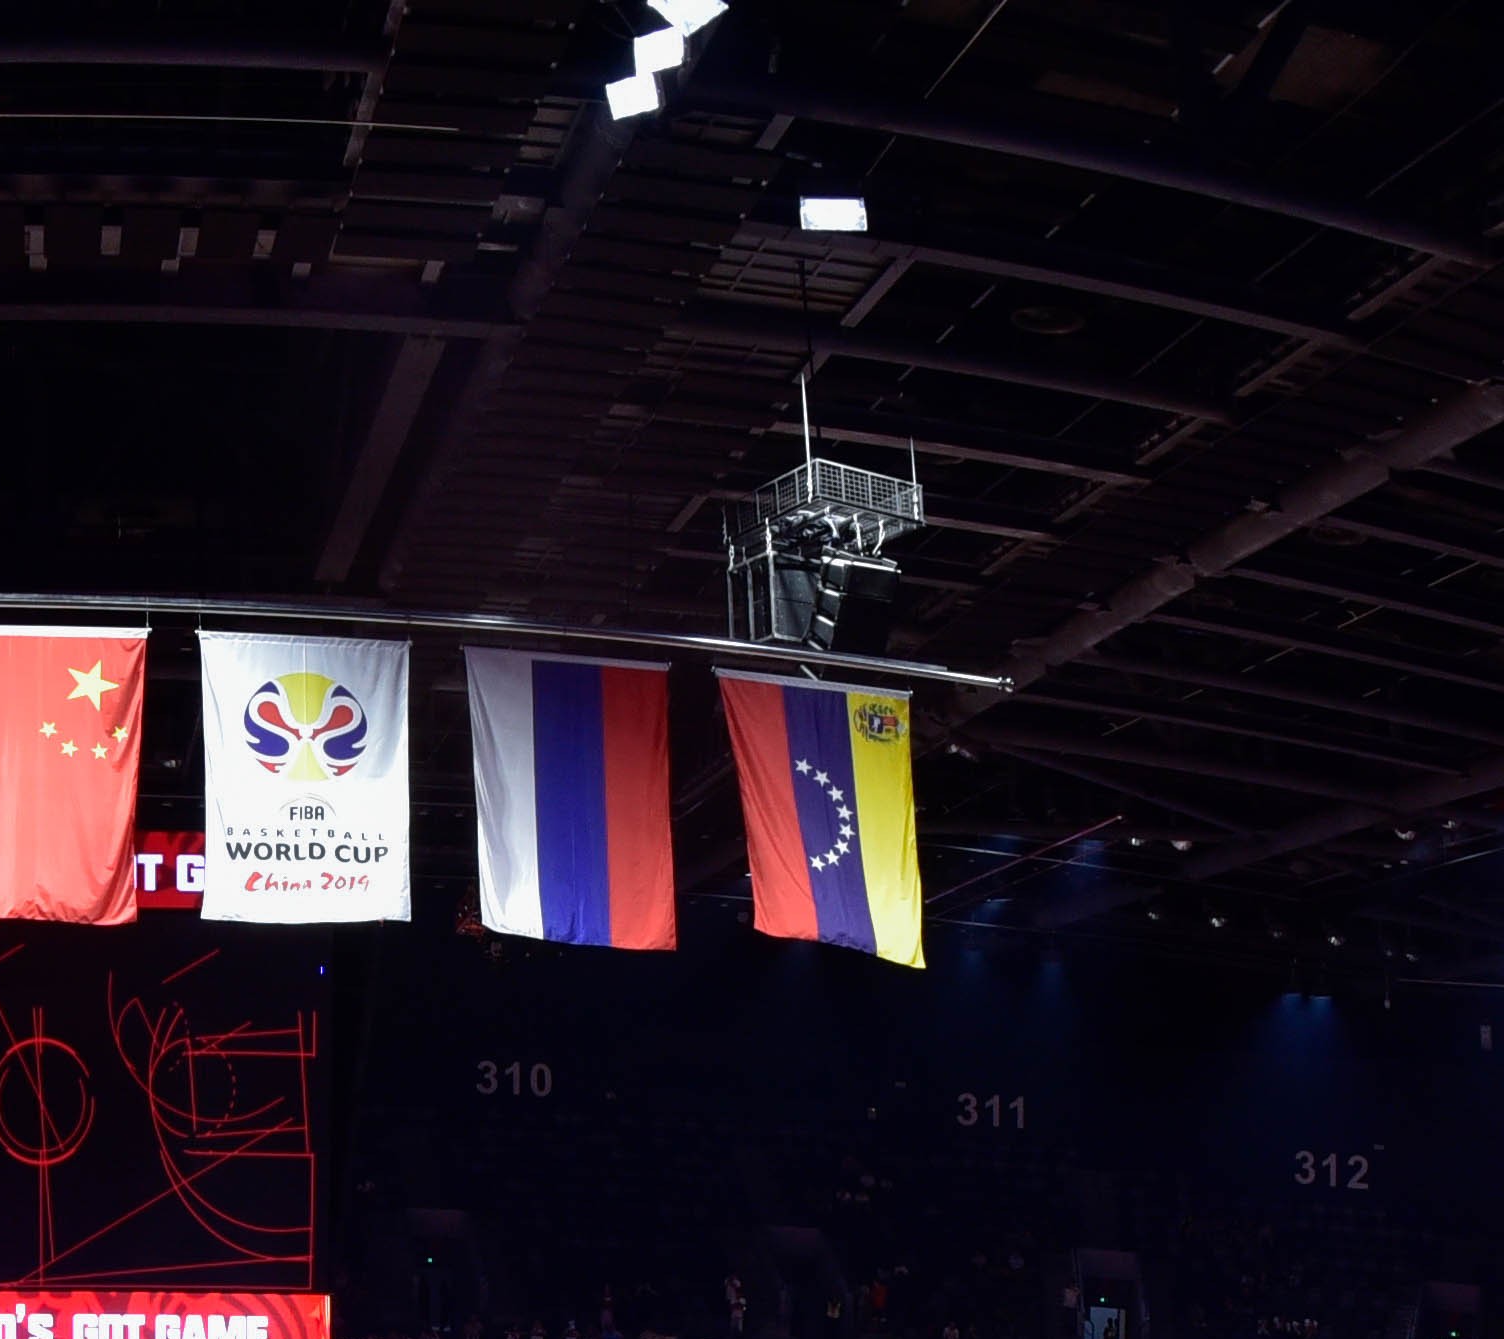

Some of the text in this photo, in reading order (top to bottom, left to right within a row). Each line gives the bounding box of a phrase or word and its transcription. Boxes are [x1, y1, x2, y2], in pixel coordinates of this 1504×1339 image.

[289, 805, 325, 821] FIBA
[226, 827, 385, 841] BASKETBALL
[226, 842, 388, 863] WORLD CUP
[244, 871, 370, 892] China 2019
[476, 1060, 552, 1097] 310
[957, 1093, 1024, 1128] 311
[1295, 1151, 1368, 1189] 312
